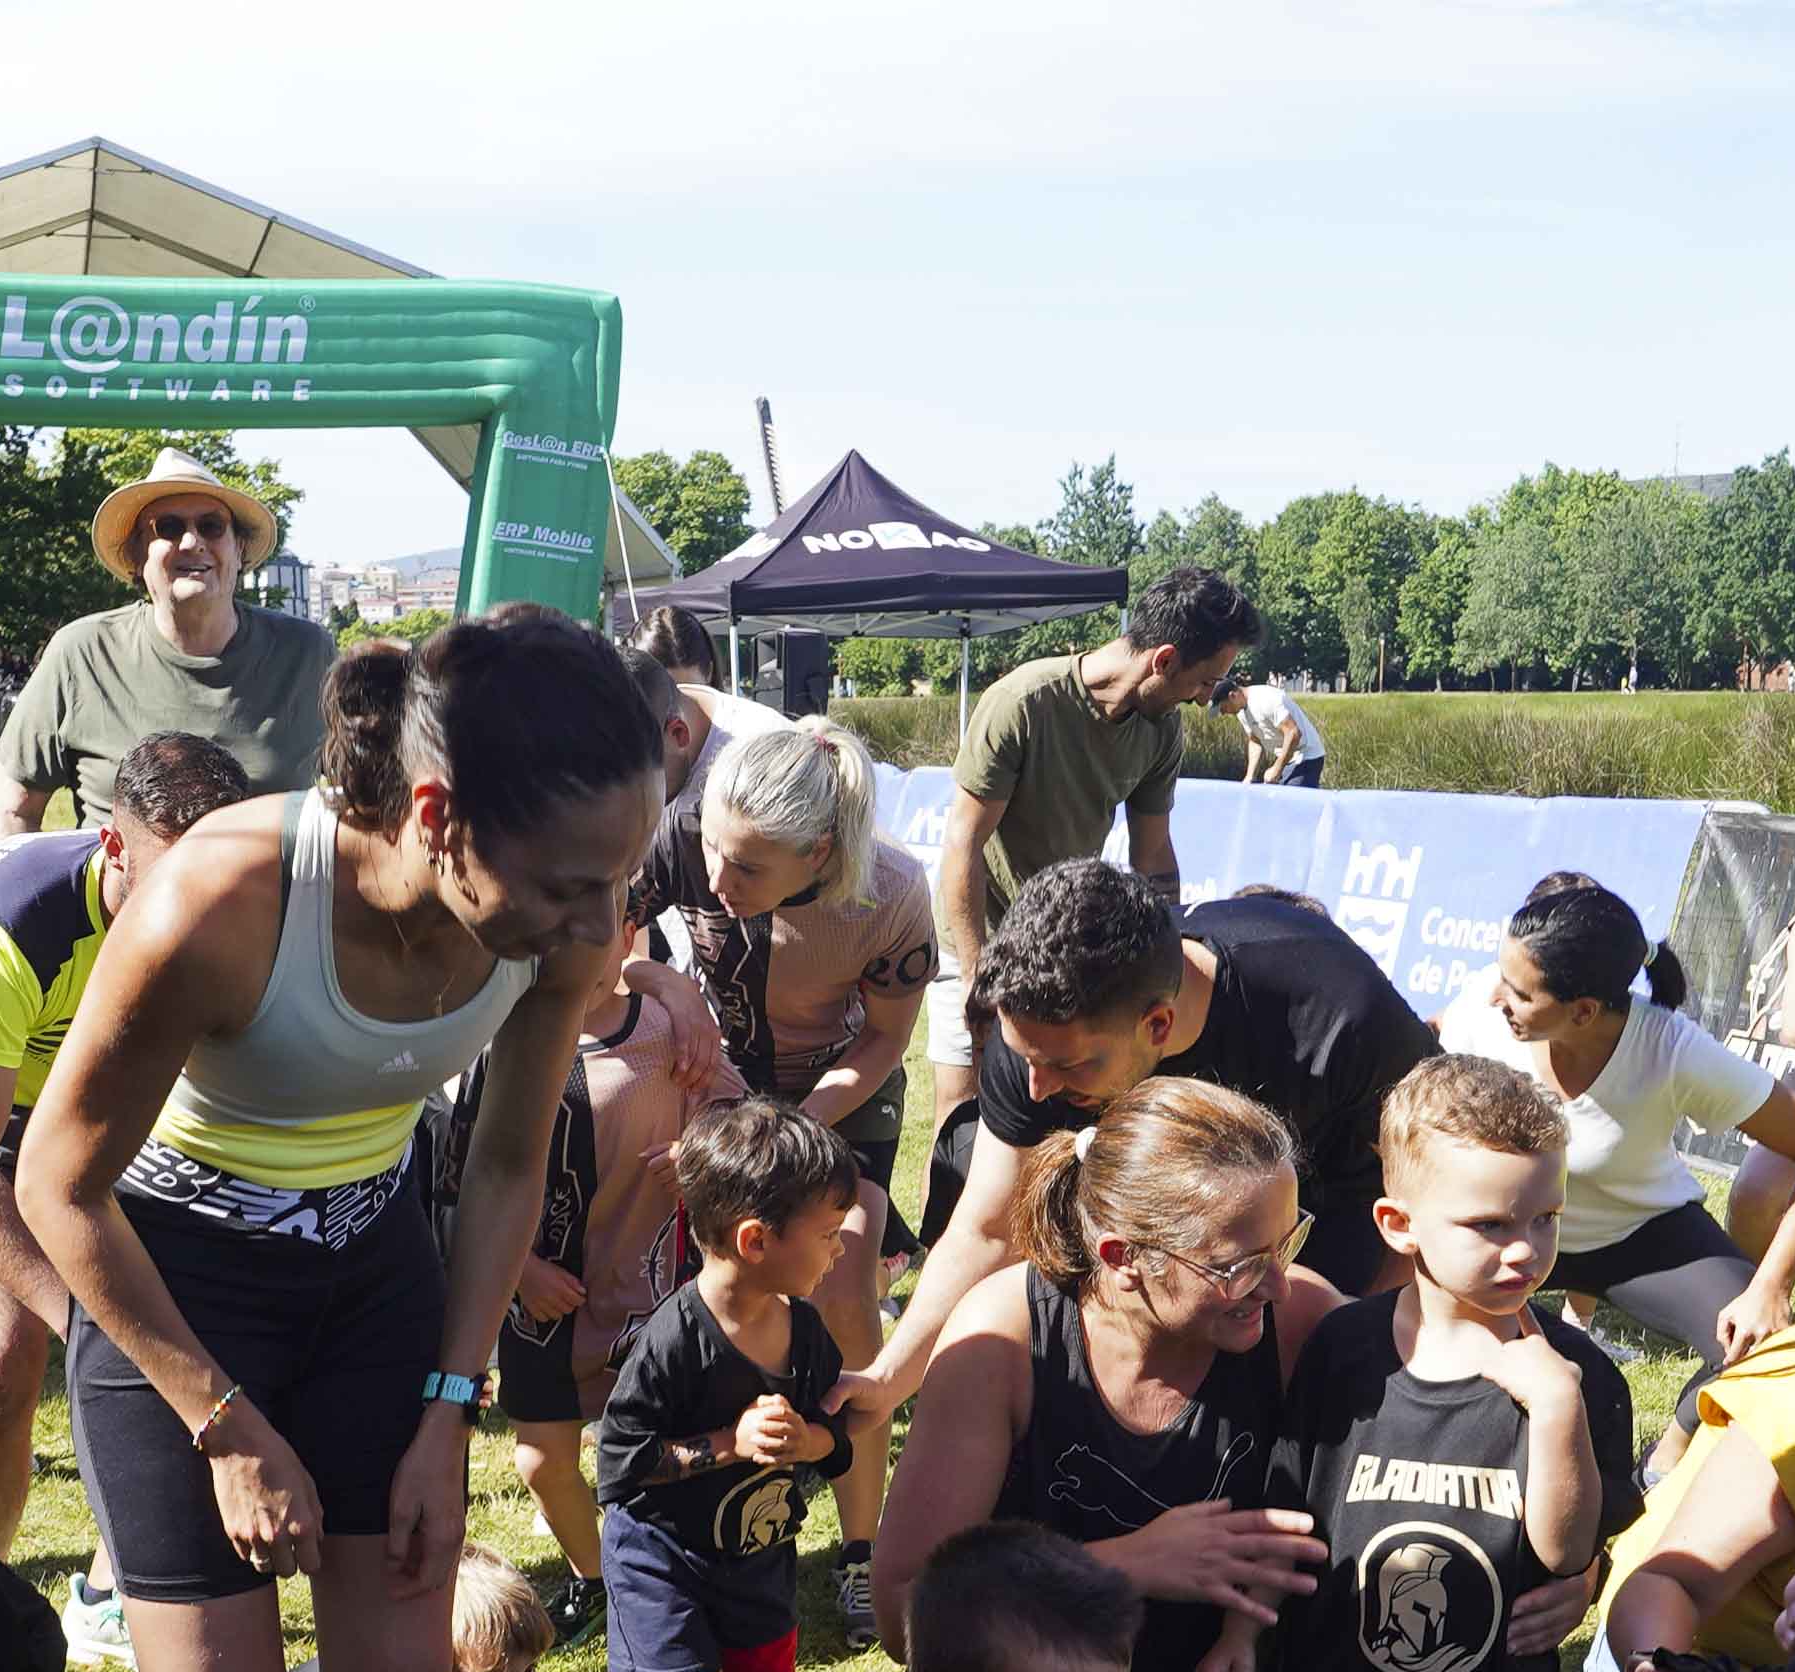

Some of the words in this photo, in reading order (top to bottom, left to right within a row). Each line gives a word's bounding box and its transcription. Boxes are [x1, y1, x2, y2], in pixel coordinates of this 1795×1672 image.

[0, 295, 310, 373] L@ndín
[4, 374, 312, 401] SOFTWARE
[494, 521, 529, 538] ERP
[533, 525, 593, 548] Mobile
[862, 942, 933, 987] 20
[1408, 955, 1443, 993] de
[1345, 1453, 1525, 1520] GLADIATOR
